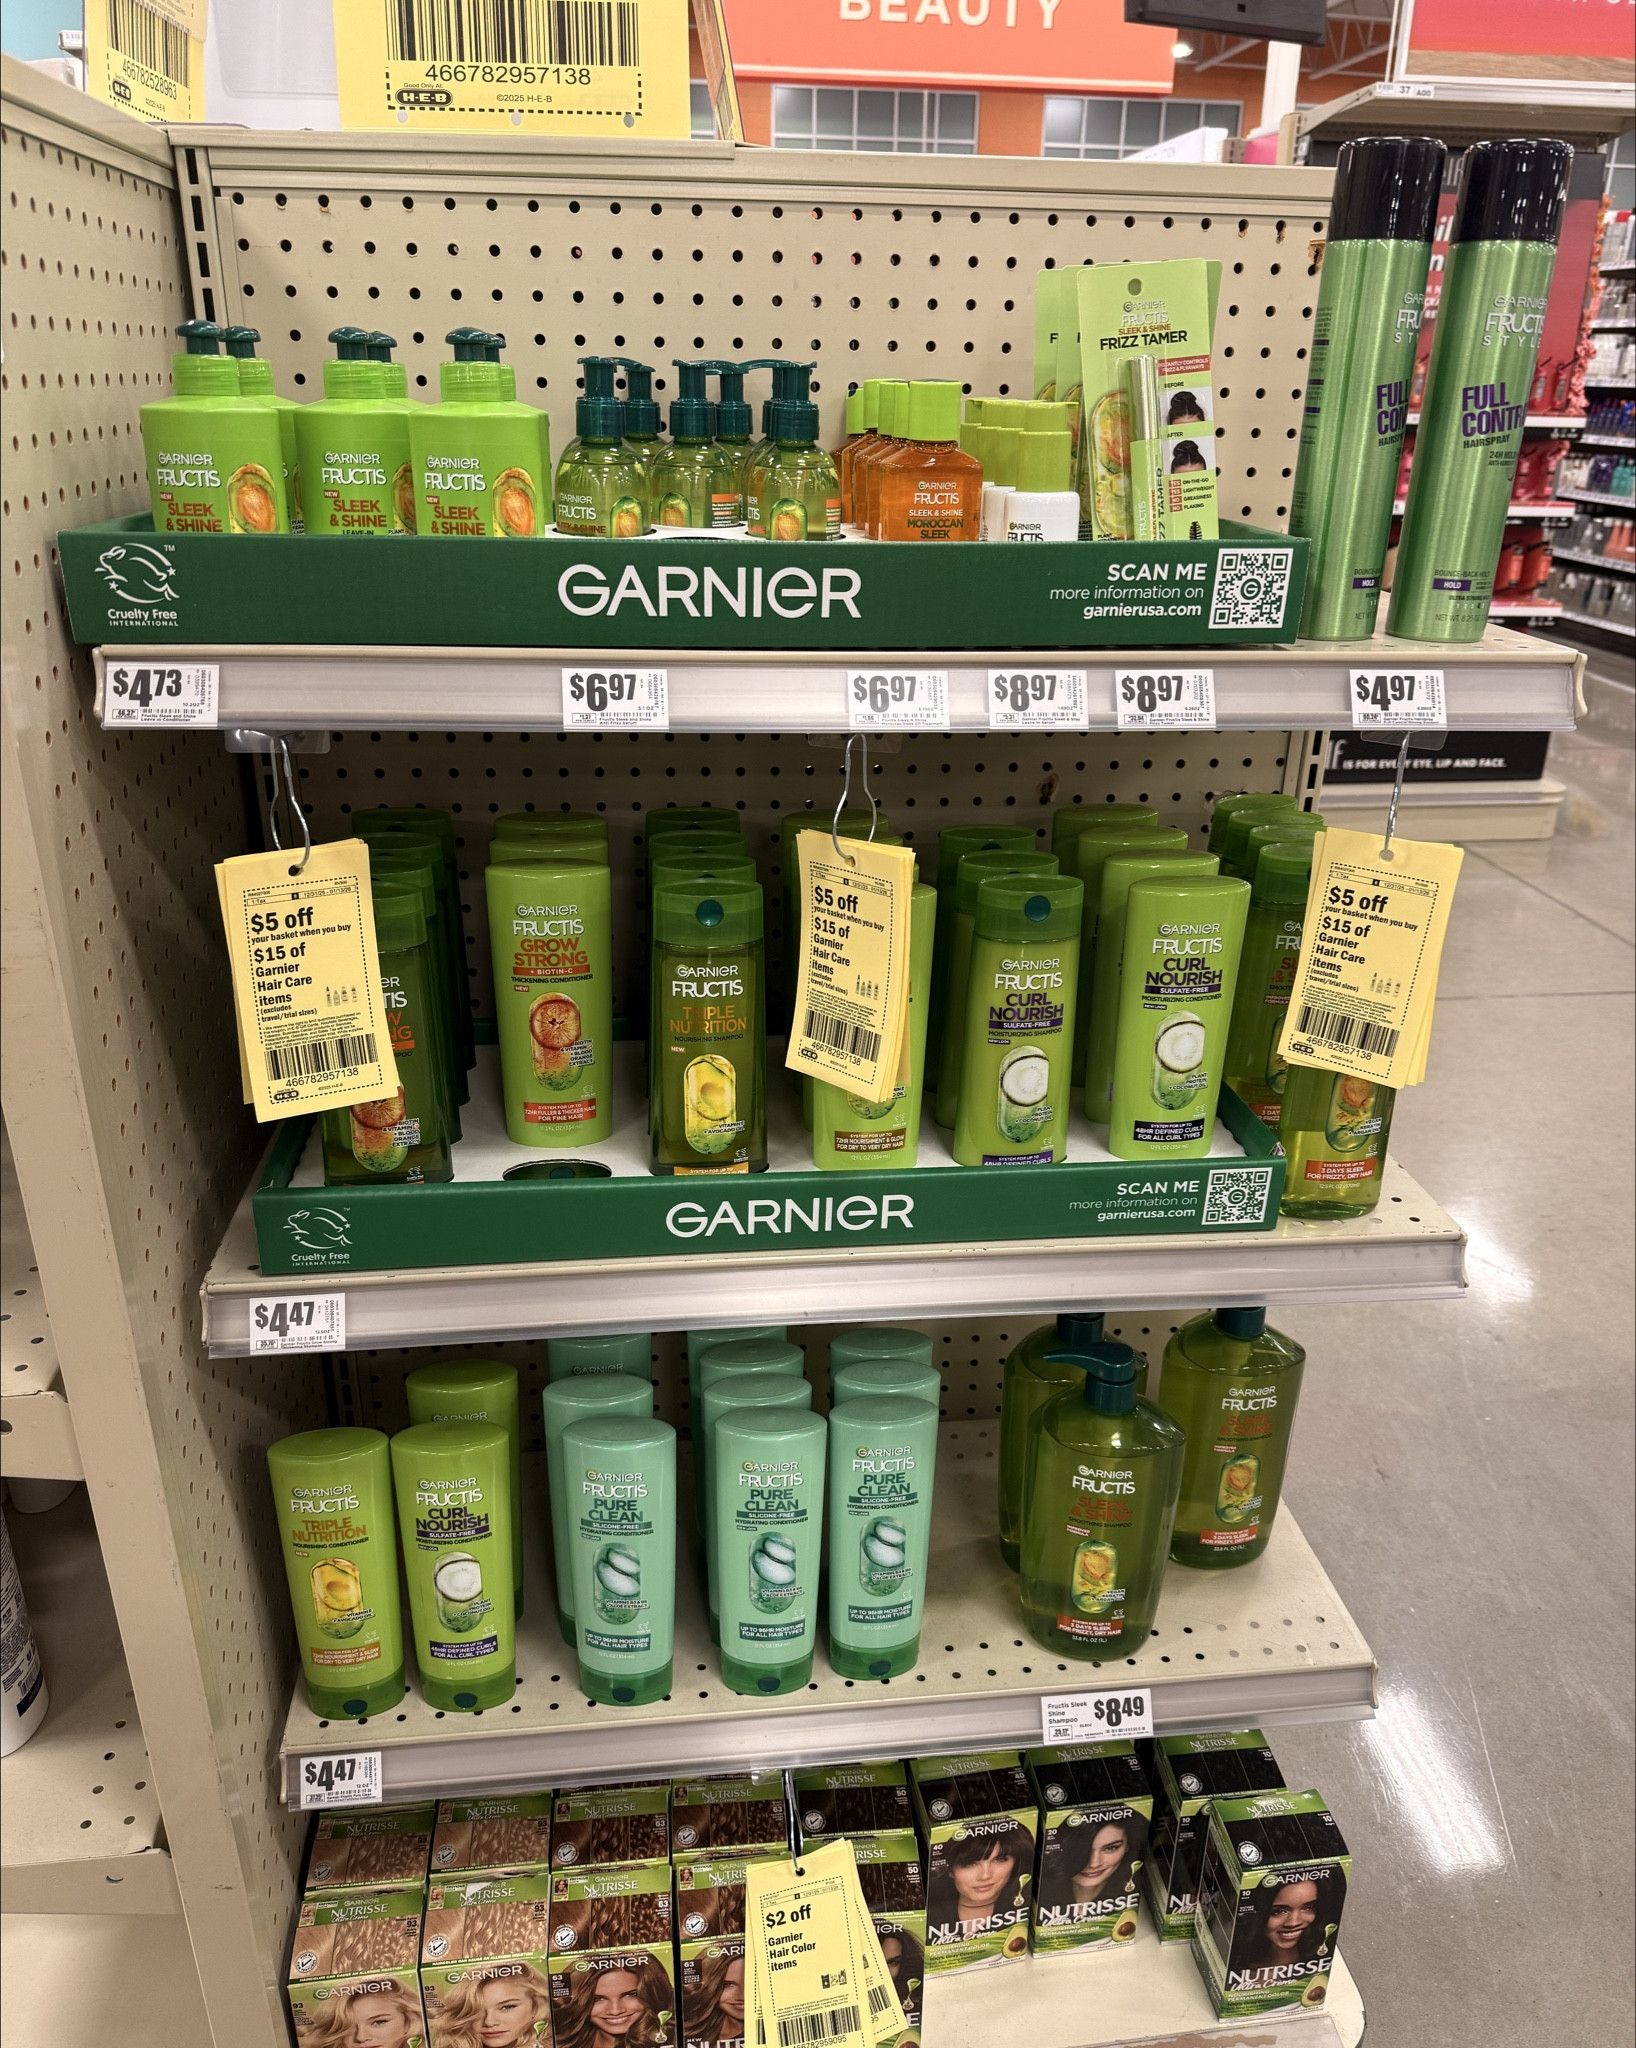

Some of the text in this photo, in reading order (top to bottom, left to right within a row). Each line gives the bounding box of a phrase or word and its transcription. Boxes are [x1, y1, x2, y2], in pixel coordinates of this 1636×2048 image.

[425, 64, 591, 85] 466782957138
[496, 94, 525, 102] ©2025
[1121, 312, 1169, 327] FRUCTIS
[1118, 323, 1172, 335] SLEEK SHINE
[1100, 330, 1188, 350] FRIZZ TAMER
[1462, 382, 1510, 411] FULL
[1463, 434, 1510, 449] HAIRSPRAY
[158, 452, 213, 466] GARNIER
[325, 451, 380, 464] GARNIER
[427, 455, 480, 470] GARNIER
[157, 469, 221, 487] FRUCTIS
[322, 467, 387, 485] FRUCTIS
[424, 472, 487, 491] FRUCTIS
[918, 481, 957, 491] GARNIER
[1183, 485, 1215, 493] LIGHTWEIGHT
[333, 500, 381, 512] SLEEK
[913, 492, 959, 504] FRUCTIS
[168, 503, 215, 517] SLEEK
[434, 506, 479, 520] SLEEK
[558, 504, 597, 520] FRUCTIS
[176, 519, 223, 532] SHINE
[342, 515, 387, 527] SHINE
[441, 521, 485, 536] SHINE
[907, 519, 964, 528] MOROCCAN
[1009, 522, 1041, 531] GARNIER
[920, 529, 951, 539] SLEEK
[1008, 532, 1044, 541] FRUCTIS
[1107, 563, 1208, 582] SCAN ME
[557, 563, 863, 619] GARNIER
[1050, 585, 1205, 600] more information on
[1443, 581, 1462, 589] HOLD
[107, 608, 178, 621] Cruelty Free
[1083, 603, 1202, 620] garnierusa.com
[113, 668, 182, 707] $473
[570, 672, 637, 712] $697
[853, 675, 917, 713] $697
[994, 674, 1057, 712] $897
[1121, 675, 1183, 712] $897
[1356, 674, 1416, 711] $497
[1343, 760, 1354, 769] IS
[1355, 760, 1377, 769] FOR
[1435, 759, 1451, 768] LIP
[1453, 758, 1477, 768] AND
[1478, 758, 1507, 768] FACE.
[814, 885, 859, 914] $5 off
[1328, 885, 1389, 914] $5 off
[517, 904, 578, 916] GARNIER
[250, 906, 314, 935] $5 off
[513, 919, 585, 937] FRUCTIS
[814, 917, 836, 939] $15
[1322, 915, 1371, 938] $15 of
[251, 923, 352, 945] your basket when you buy
[1160, 923, 1220, 936] GARNIER
[520, 937, 579, 952] GROW
[1152, 937, 1223, 955] FRUCTIS
[1319, 932, 1359, 950] Garnier
[254, 942, 307, 965] $15 of
[514, 951, 588, 967] STRONG
[1315, 944, 1366, 965] Hair Care
[255, 962, 300, 979] Garnier
[676, 964, 739, 978] GARNIER
[1001, 958, 1060, 971] GARNIER
[1163, 957, 1211, 971] CURL
[1312, 957, 1343, 973] items
[257, 975, 313, 992] Hair Care
[995, 972, 1063, 990] FRUCTIS
[1146, 969, 1223, 986] NOURISH
[672, 979, 744, 998] FRUCTIS
[1160, 986, 1209, 994] SULFATE-FREE
[259, 993, 293, 1007] items
[1006, 993, 1052, 1007] CURL
[989, 1003, 1064, 1021] NOURISH
[1003, 1020, 1051, 1028] SULFATE-FREE
[1305, 1035, 1373, 1061] 466782957138
[285, 1067, 359, 1088] 466782957138
[1116, 1180, 1200, 1196] SCAN ME
[665, 1194, 915, 1238] GARNIER
[1097, 1209, 1196, 1222] garnierusa.com
[291, 1252, 350, 1263] Cruelty Free
[255, 1301, 315, 1337] $447
[1221, 1395, 1278, 1411] FRUCTIS
[856, 1445, 912, 1458] GARNIER
[738, 1471, 804, 1488] FRUCTIS
[863, 1472, 906, 1485] PURE
[1078, 1464, 1133, 1479] GARNIER
[419, 1477, 477, 1490] GARNIER
[583, 1481, 648, 1499] FRUCTIS
[857, 1482, 911, 1496] CLEAN
[1072, 1475, 1136, 1495] FRUCTIS
[750, 1488, 794, 1500] PURE
[290, 1495, 360, 1514] FRUCTIS
[594, 1498, 638, 1511] PURE
[744, 1499, 799, 1512] CLEAN
[428, 1506, 475, 1520] CURL
[588, 1509, 644, 1523] CLEAN
[302, 1516, 352, 1531] TRIPLE
[416, 1512, 489, 1532] NOURISH
[292, 1525, 367, 1543] NUTRITION
[1048, 1717, 1078, 1725] Shampoo
[305, 1758, 356, 1791] $447
[467, 1804, 520, 1817] NUTRISSE
[1066, 1809, 1133, 1827] GARNIER
[952, 1821, 1019, 1841] GARNIER
[1263, 1868, 1330, 1888] GARNIER
[583, 1880, 639, 1894] NUTRISSE
[330, 1904, 388, 1919] NUTRISSE
[1039, 1892, 1140, 1921] NUTRISSE
[766, 1904, 812, 1929] $2 off
[929, 1907, 1029, 1940] NUTRISSE
[768, 1931, 804, 1947] Garnier
[769, 1941, 817, 1959] Hair Color
[575, 1956, 649, 1972] GARNIER
[771, 1958, 798, 1971] items
[1228, 1956, 1332, 1985] NUTRISSE
[446, 1965, 523, 1983] GARNIER
[313, 1981, 393, 2000] GARNIER
